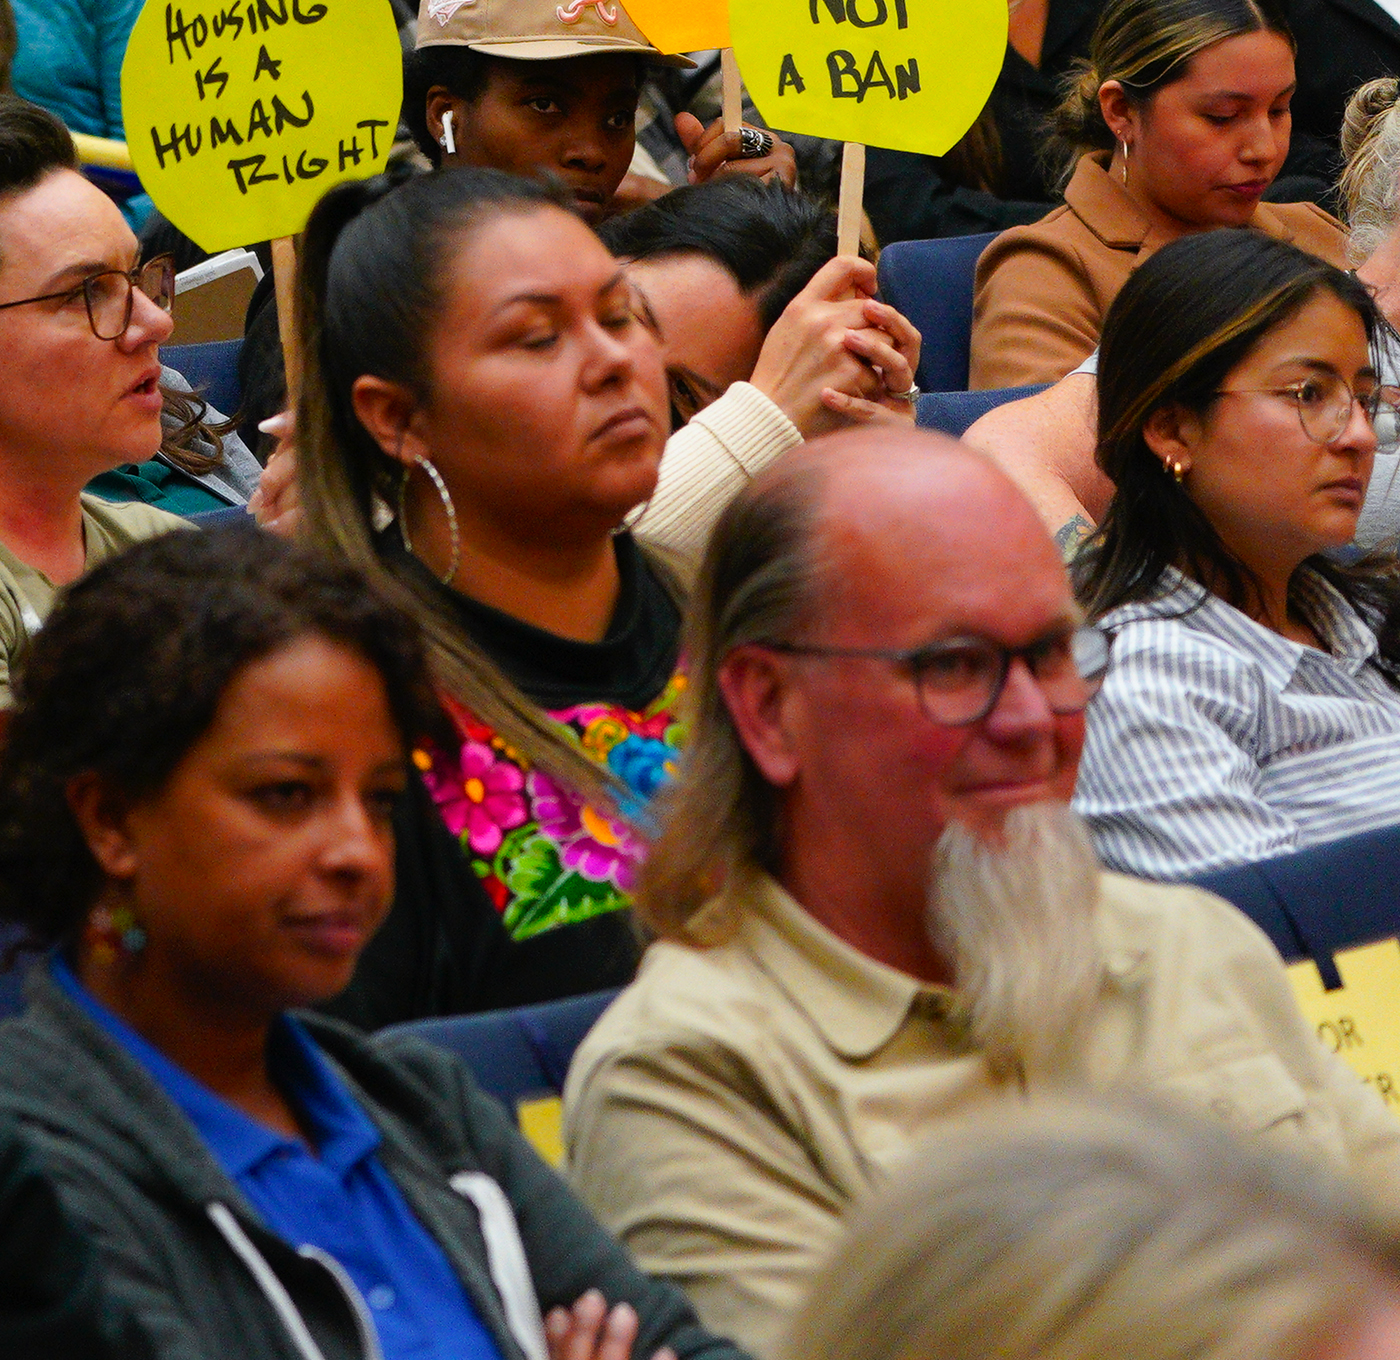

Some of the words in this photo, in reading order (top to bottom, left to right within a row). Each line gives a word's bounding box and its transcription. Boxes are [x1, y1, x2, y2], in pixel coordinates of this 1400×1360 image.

[195, 56, 229, 101] IS
[253, 44, 282, 82] A
[778, 54, 806, 97] A
[826, 50, 922, 103] BAN
[151, 90, 314, 169] HUMAN
[227, 120, 389, 195] RIGHT
